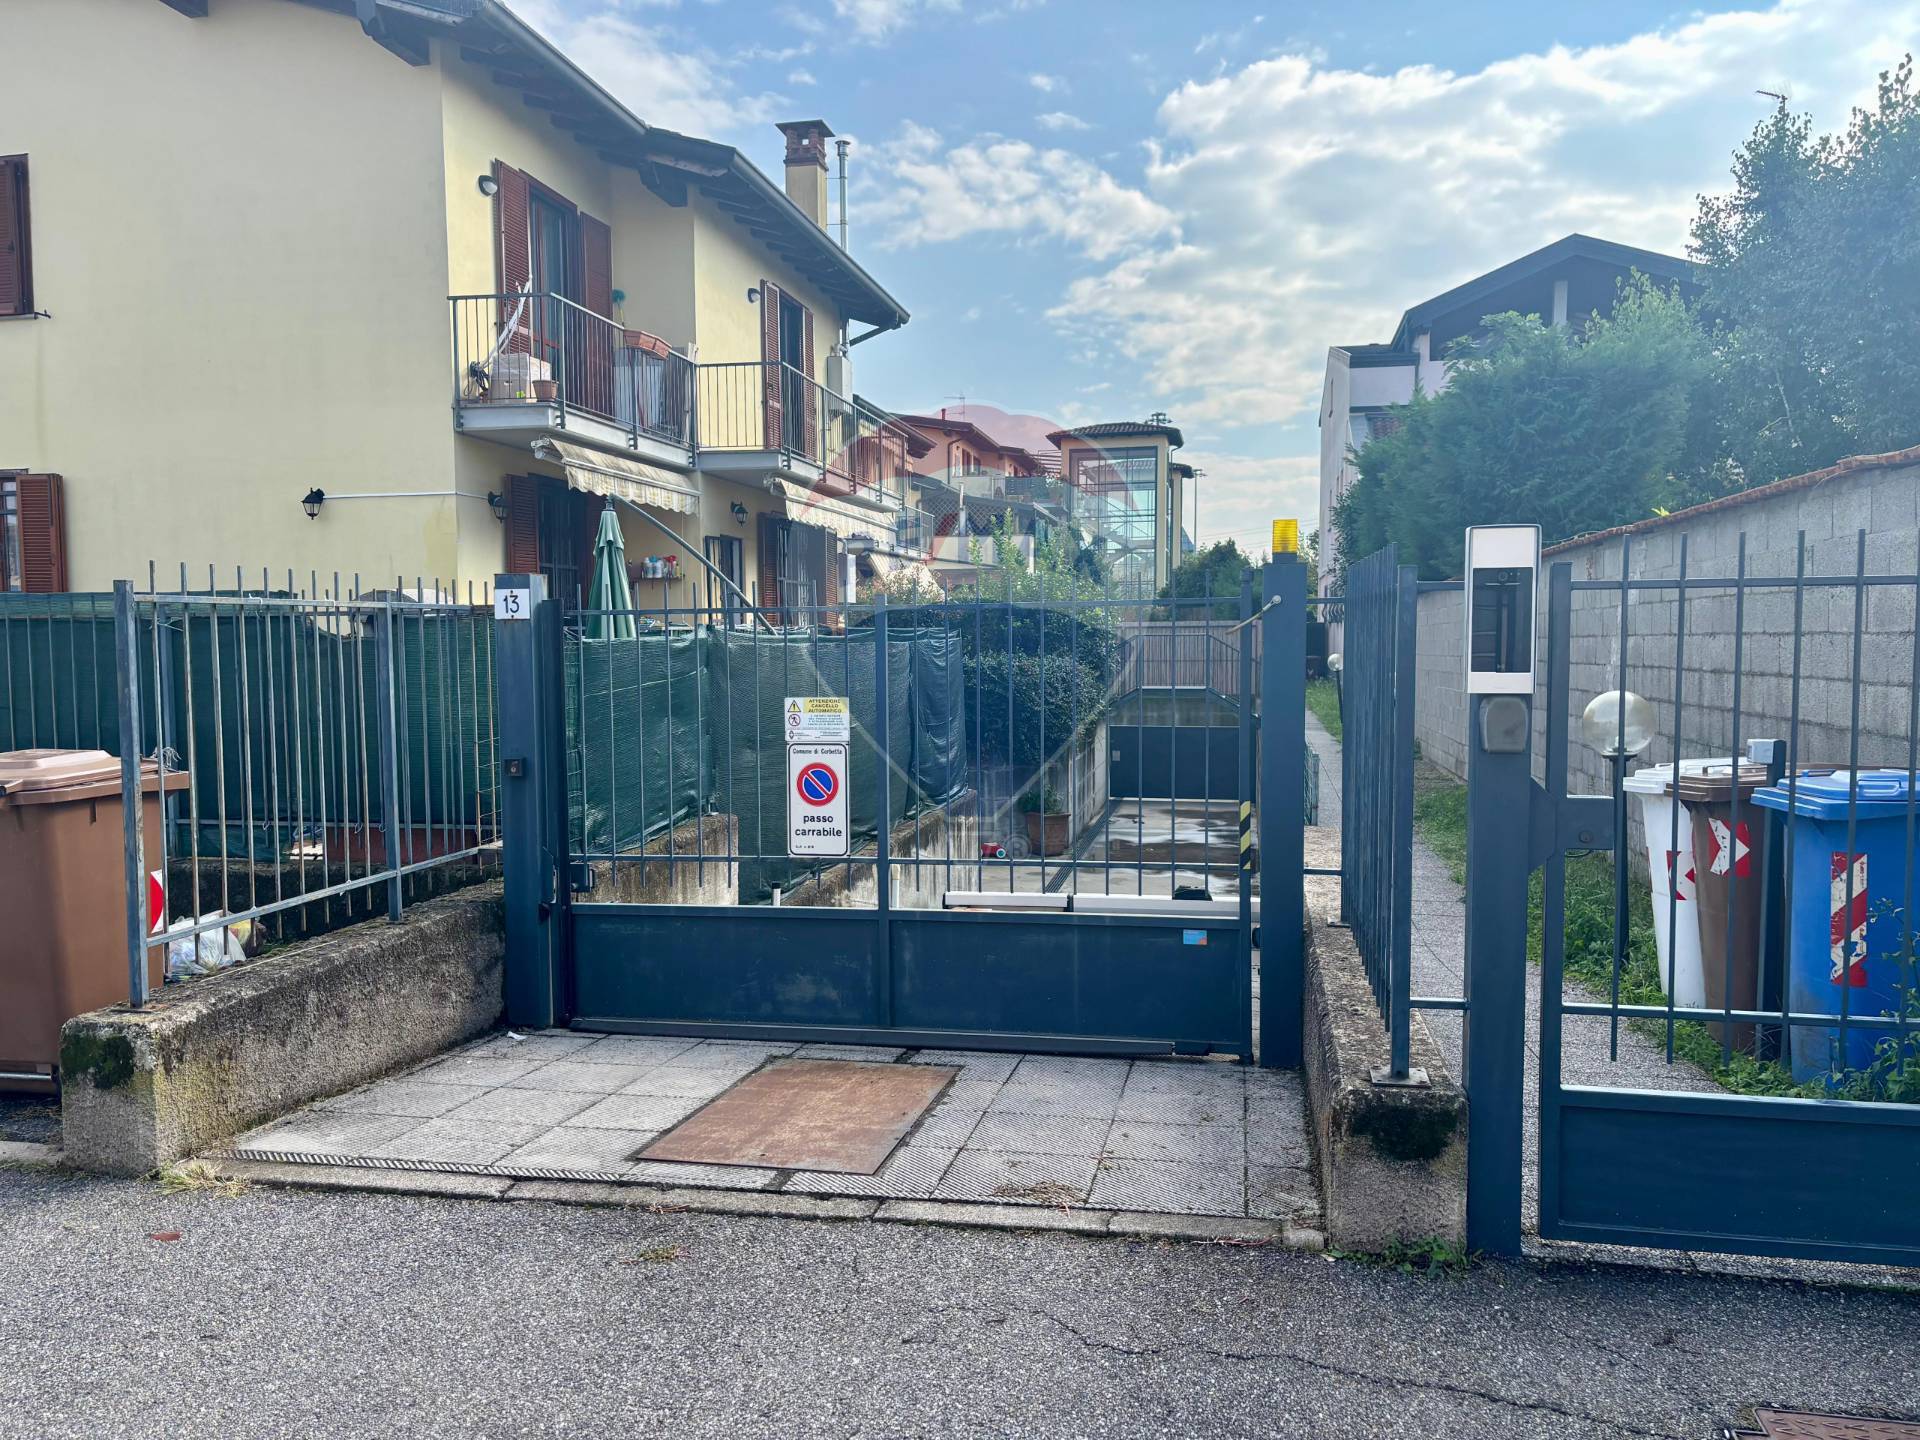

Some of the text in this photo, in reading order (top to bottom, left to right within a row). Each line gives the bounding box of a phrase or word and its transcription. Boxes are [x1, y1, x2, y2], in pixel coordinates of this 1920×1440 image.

[503, 595, 520, 614] 13
[803, 815, 834, 824] passo
[795, 828, 842, 837] carrabile
